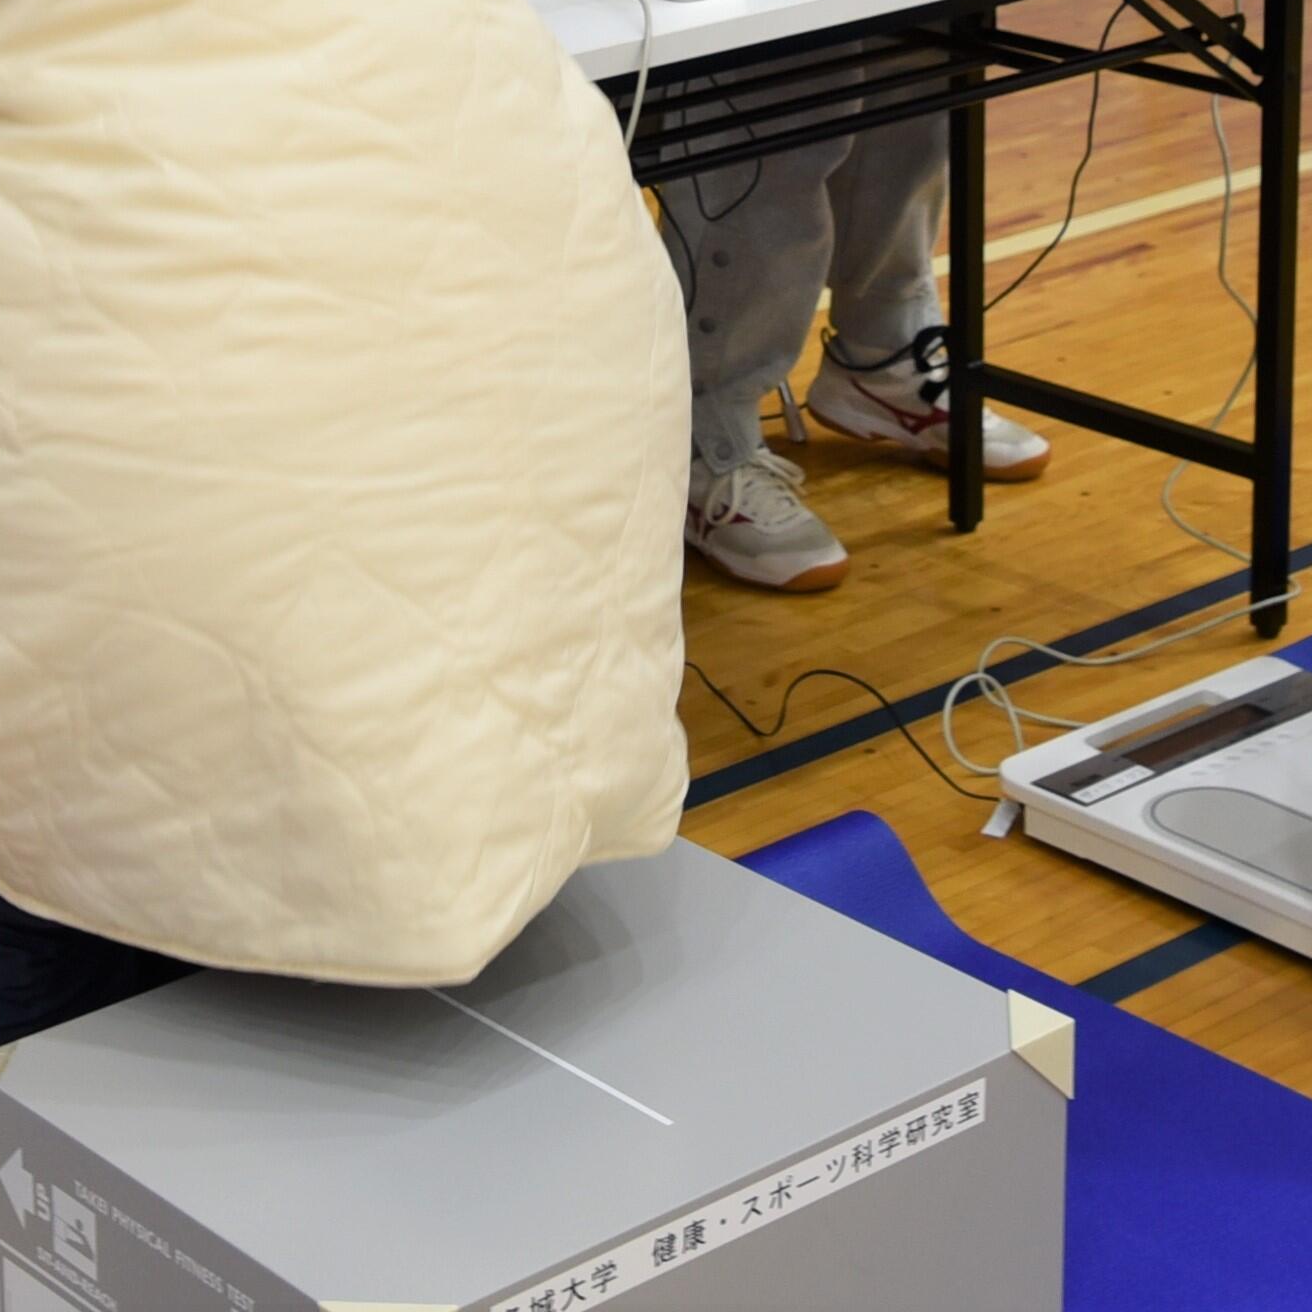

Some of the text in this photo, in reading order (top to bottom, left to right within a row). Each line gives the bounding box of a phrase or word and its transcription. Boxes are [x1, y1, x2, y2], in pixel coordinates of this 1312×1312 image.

[36, 1182, 51, 1222] UP
[505, 1090, 981, 1312] 城大学 健康・スポーツ科学研究室
